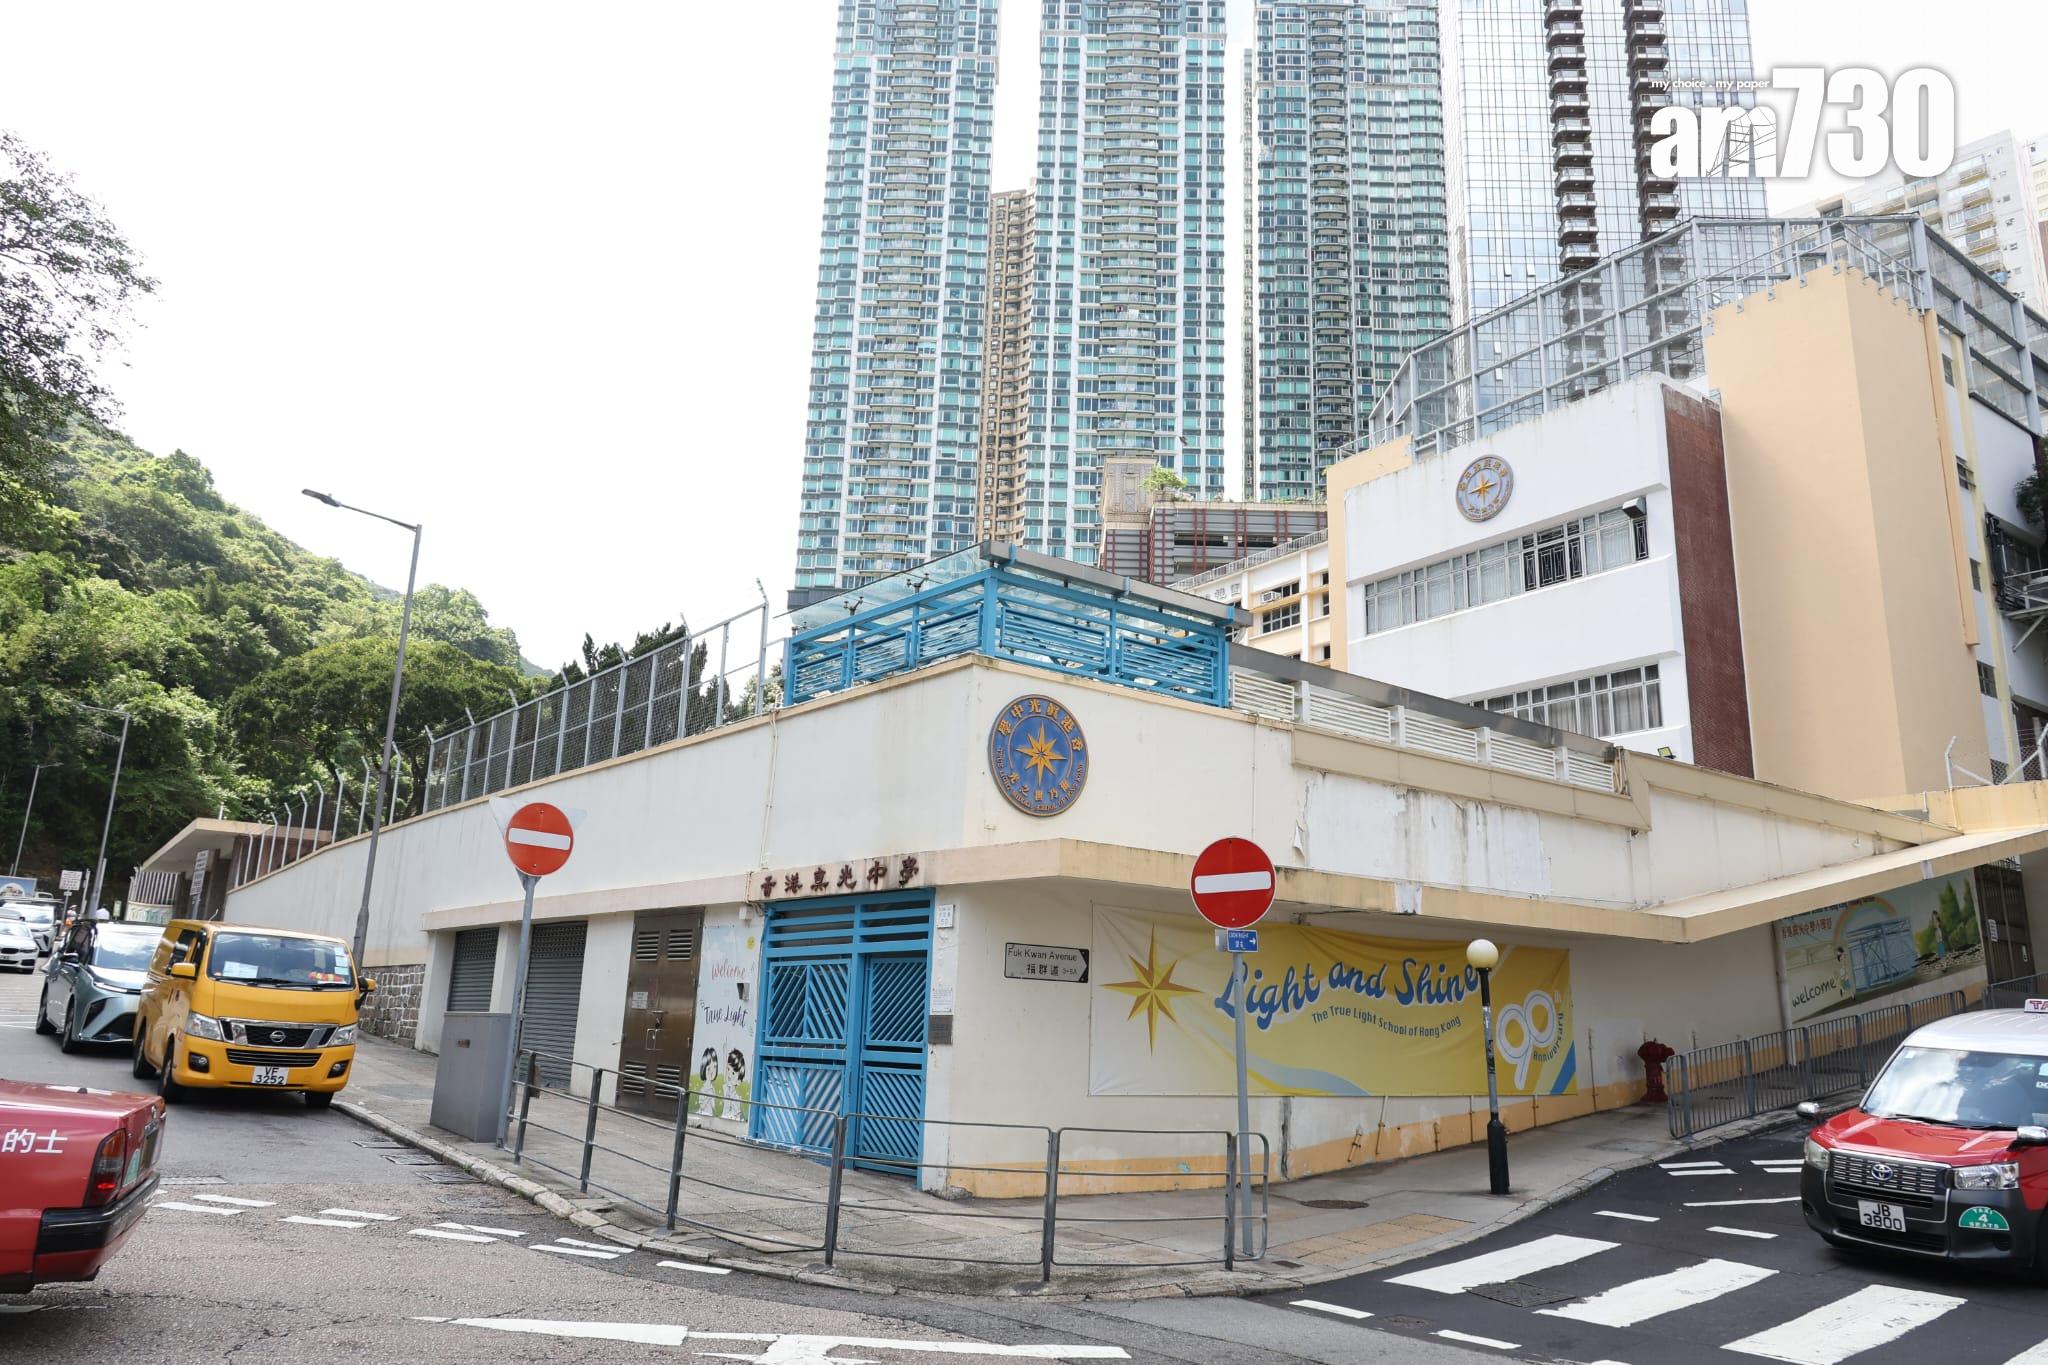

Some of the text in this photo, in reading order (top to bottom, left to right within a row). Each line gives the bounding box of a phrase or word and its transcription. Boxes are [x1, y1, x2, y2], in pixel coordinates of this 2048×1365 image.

[1008, 947, 1078, 962] Fuk Kwan Avenue
[1026, 963, 1059, 977] 福群道
[1215, 958, 1480, 1030] Light and Shine
[1791, 976, 1837, 1009] welcome
[704, 1004, 748, 1029] True Light
[1312, 1005, 1462, 1039] The True Light School of Hong Kong
[264, 1067, 280, 1076] VF
[255, 1074, 285, 1085] 3252
[2, 1128, 68, 1153] 的士
[1872, 1203, 1891, 1217] JB
[1979, 1213, 1988, 1222] 4
[1863, 1214, 1903, 1231] 3800
[1968, 1221, 2000, 1229] SEATS
